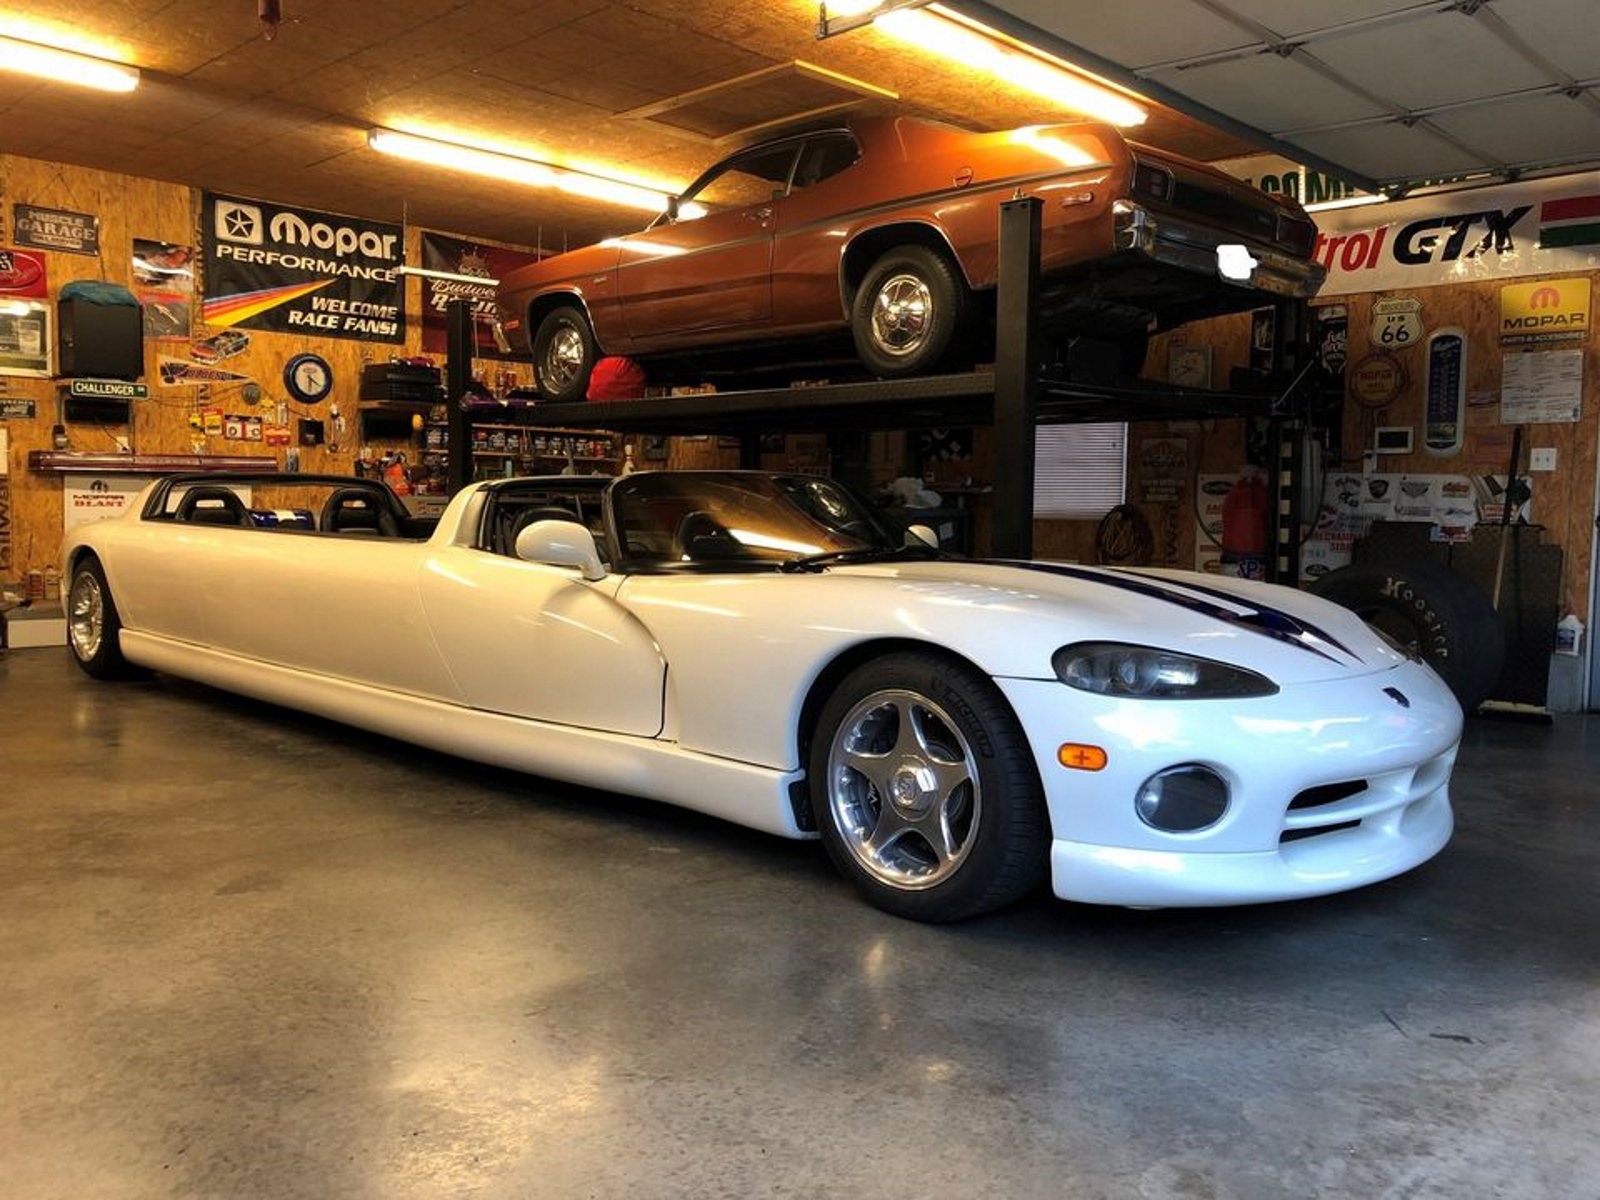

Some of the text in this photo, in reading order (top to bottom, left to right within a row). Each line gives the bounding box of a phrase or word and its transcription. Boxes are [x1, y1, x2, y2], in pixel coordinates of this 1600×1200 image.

[17, 218, 95, 241] GARAGE
[28, 211, 84, 227] MUSCLE
[1393, 204, 1535, 266] GTX
[216, 244, 397, 283] PERFORMANCE
[311, 296, 398, 320] WELCOME
[288, 309, 398, 336] RACE FANS!
[1503, 312, 1585, 331] MOPAR
[1381, 325, 1410, 343] 66
[75, 382, 134, 395] CHALLENGER
